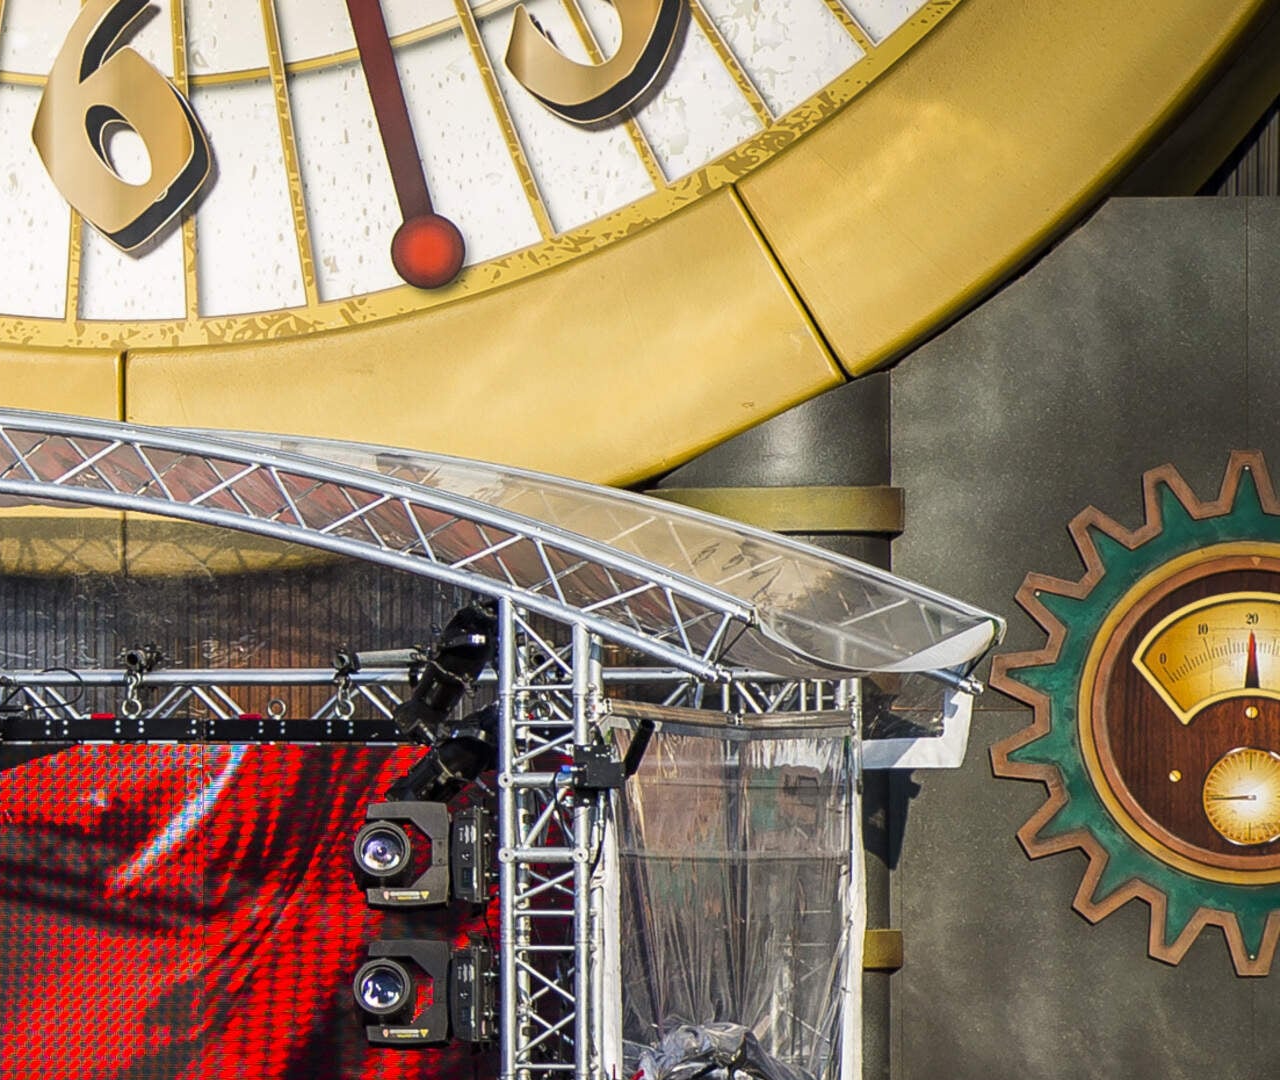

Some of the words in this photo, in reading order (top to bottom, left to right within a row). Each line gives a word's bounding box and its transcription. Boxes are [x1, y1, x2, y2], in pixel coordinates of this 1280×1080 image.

[30, 0, 208, 250] 6
[1159, 653, 1167, 664] 0
[1197, 623, 1208, 635] 10
[1245, 612, 1259, 625] 20
